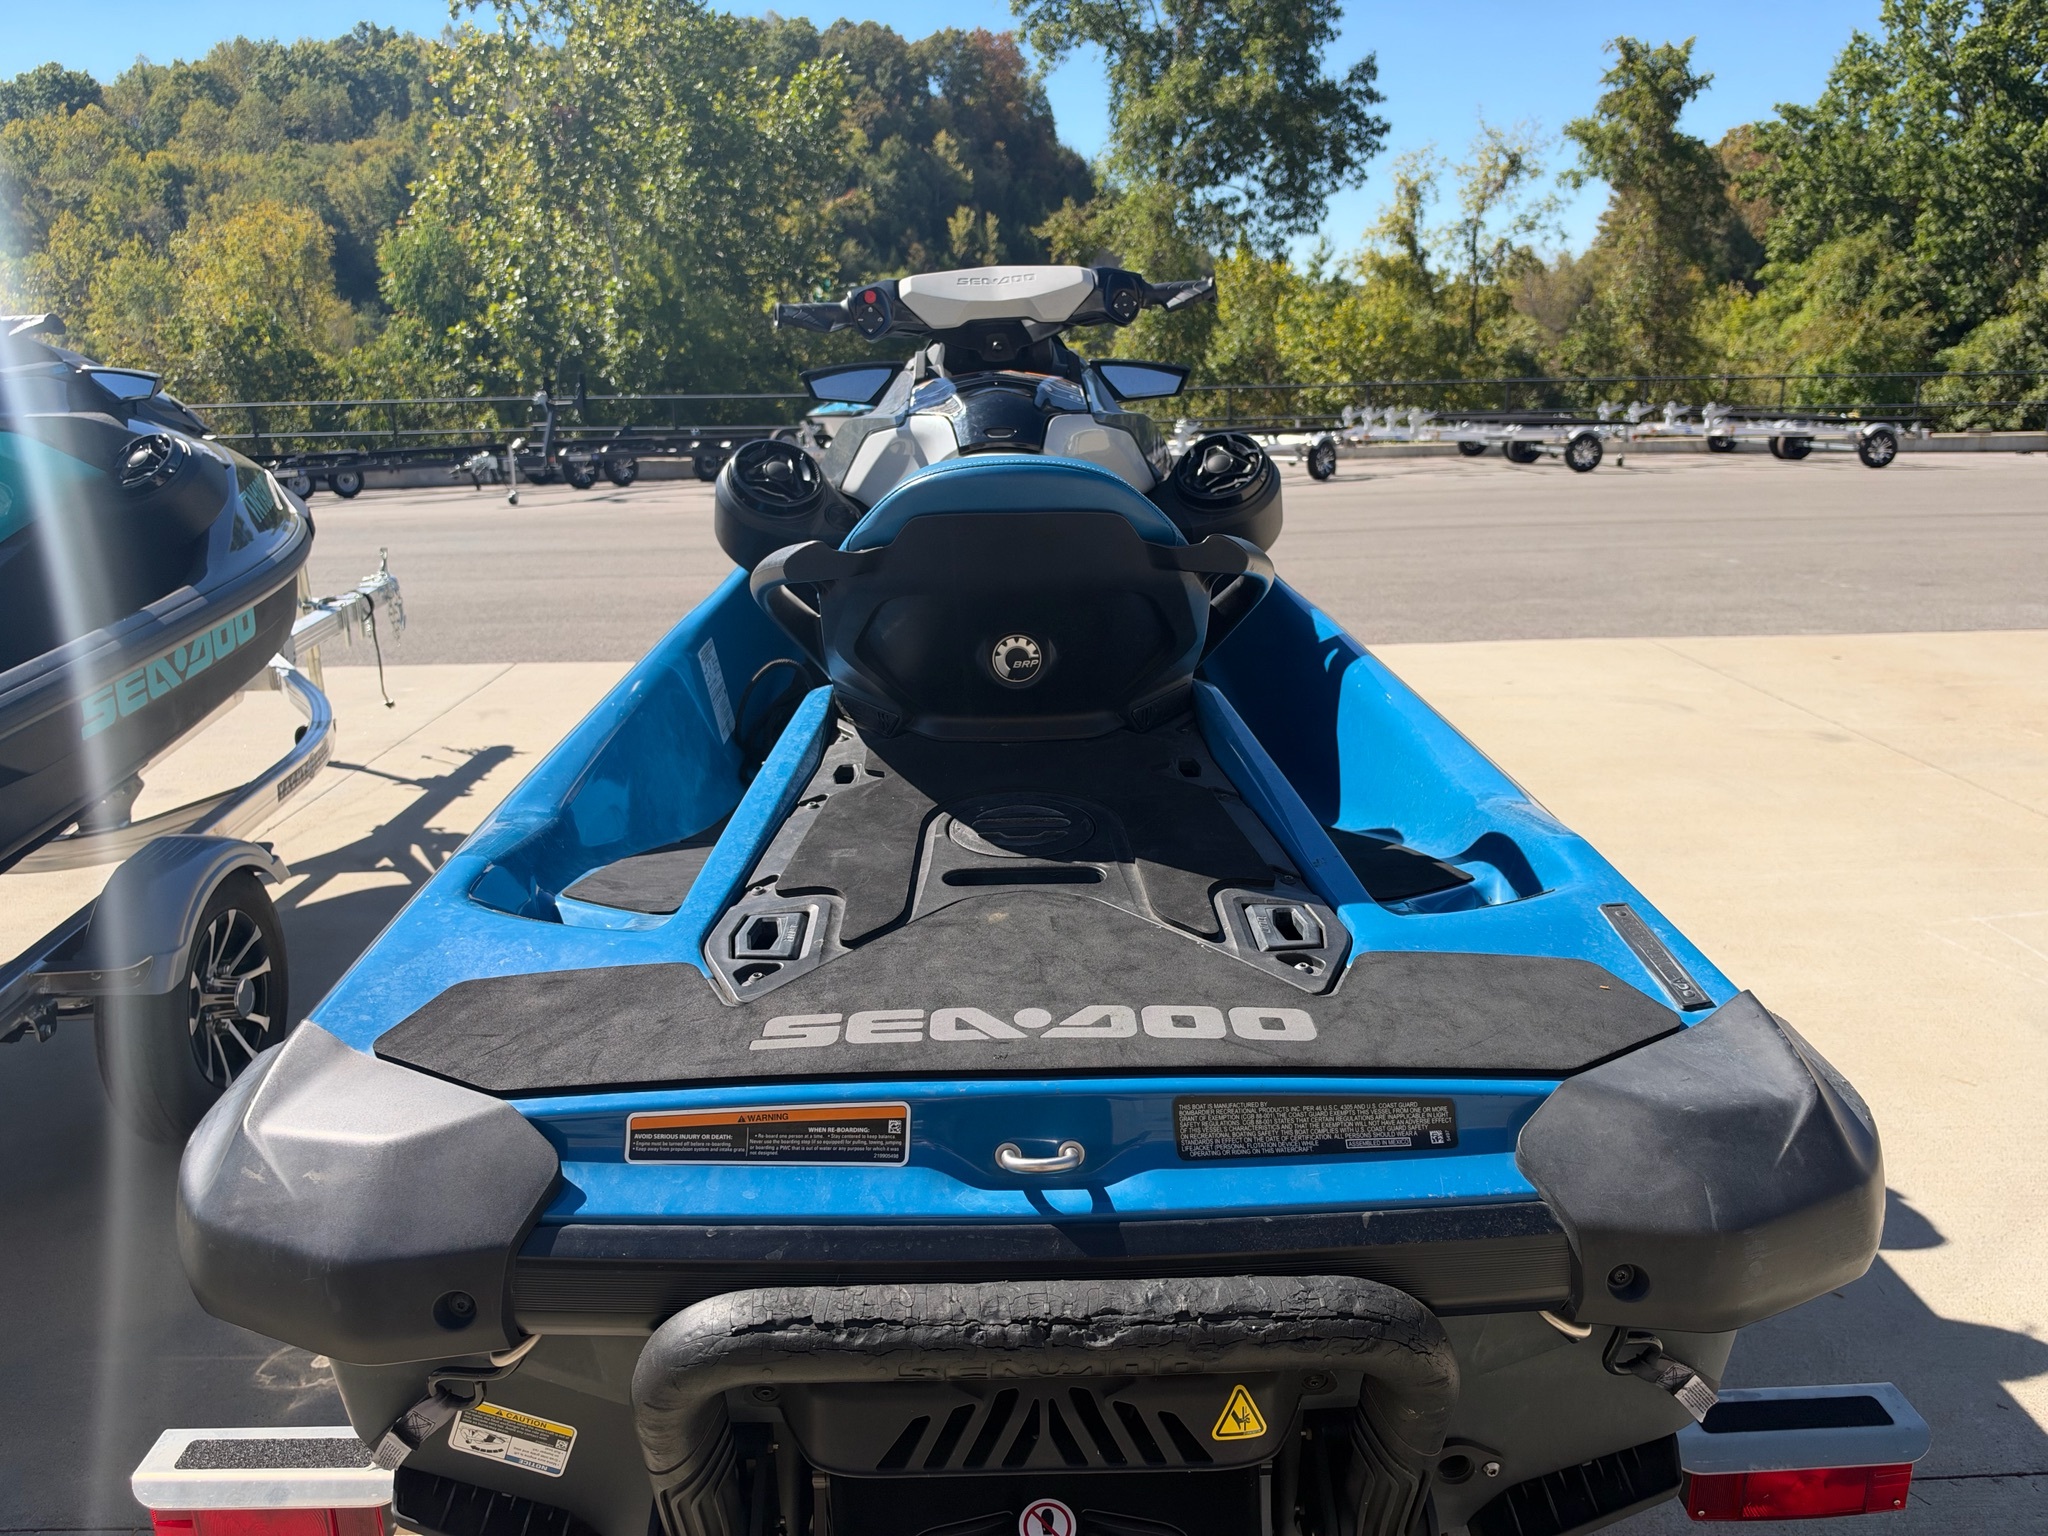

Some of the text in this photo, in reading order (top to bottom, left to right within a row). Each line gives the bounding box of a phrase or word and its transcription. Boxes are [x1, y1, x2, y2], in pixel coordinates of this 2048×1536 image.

[1012, 660, 1039, 668] BRP
[747, 1113, 789, 1122] WARNING
[506, 1412, 548, 1428] CAUTION
[518, 1459, 548, 1471] NOTICE
